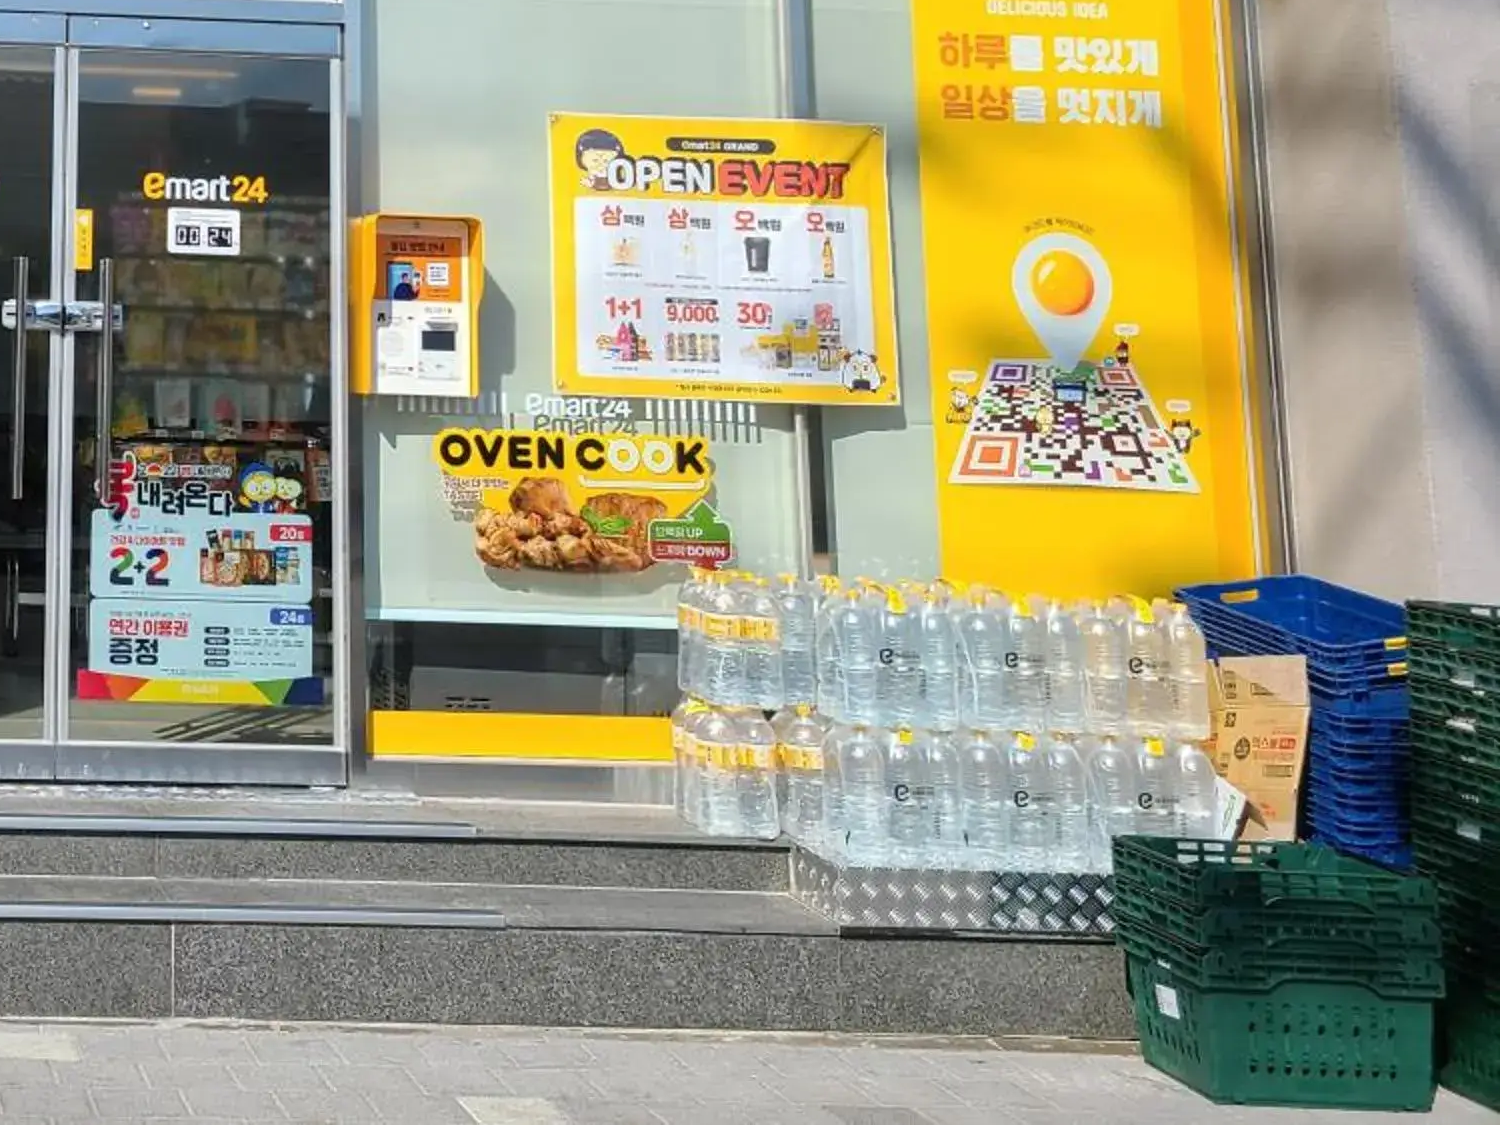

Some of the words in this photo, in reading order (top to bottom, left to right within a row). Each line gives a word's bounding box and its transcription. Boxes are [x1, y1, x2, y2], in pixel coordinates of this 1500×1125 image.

[1073, 1, 1109, 20] IDEA
[937, 31, 1044, 73] 하루를
[1053, 36, 1159, 76] 맛있게
[940, 85, 1047, 125] 일상을
[1057, 87, 1162, 128] 멋지게
[724, 142, 759, 152] GRAND
[143, 172, 269, 204] emart24
[608, 157, 713, 195] OPEN
[717, 161, 850, 199] EVENT
[208, 227, 232, 247] 24
[605, 297, 643, 320] 1+1
[525, 393, 633, 419] emart24
[440, 433, 565, 470] OVEN
[575, 437, 706, 475] COOK
[136, 479, 235, 516] 내려온다
[686, 527, 704, 538] UP
[687, 545, 726, 558] DOWN
[109, 548, 170, 587] 2+2
[109, 618, 139, 636] 연간
[143, 619, 189, 637] 이용권
[109, 639, 159, 666] 증정
